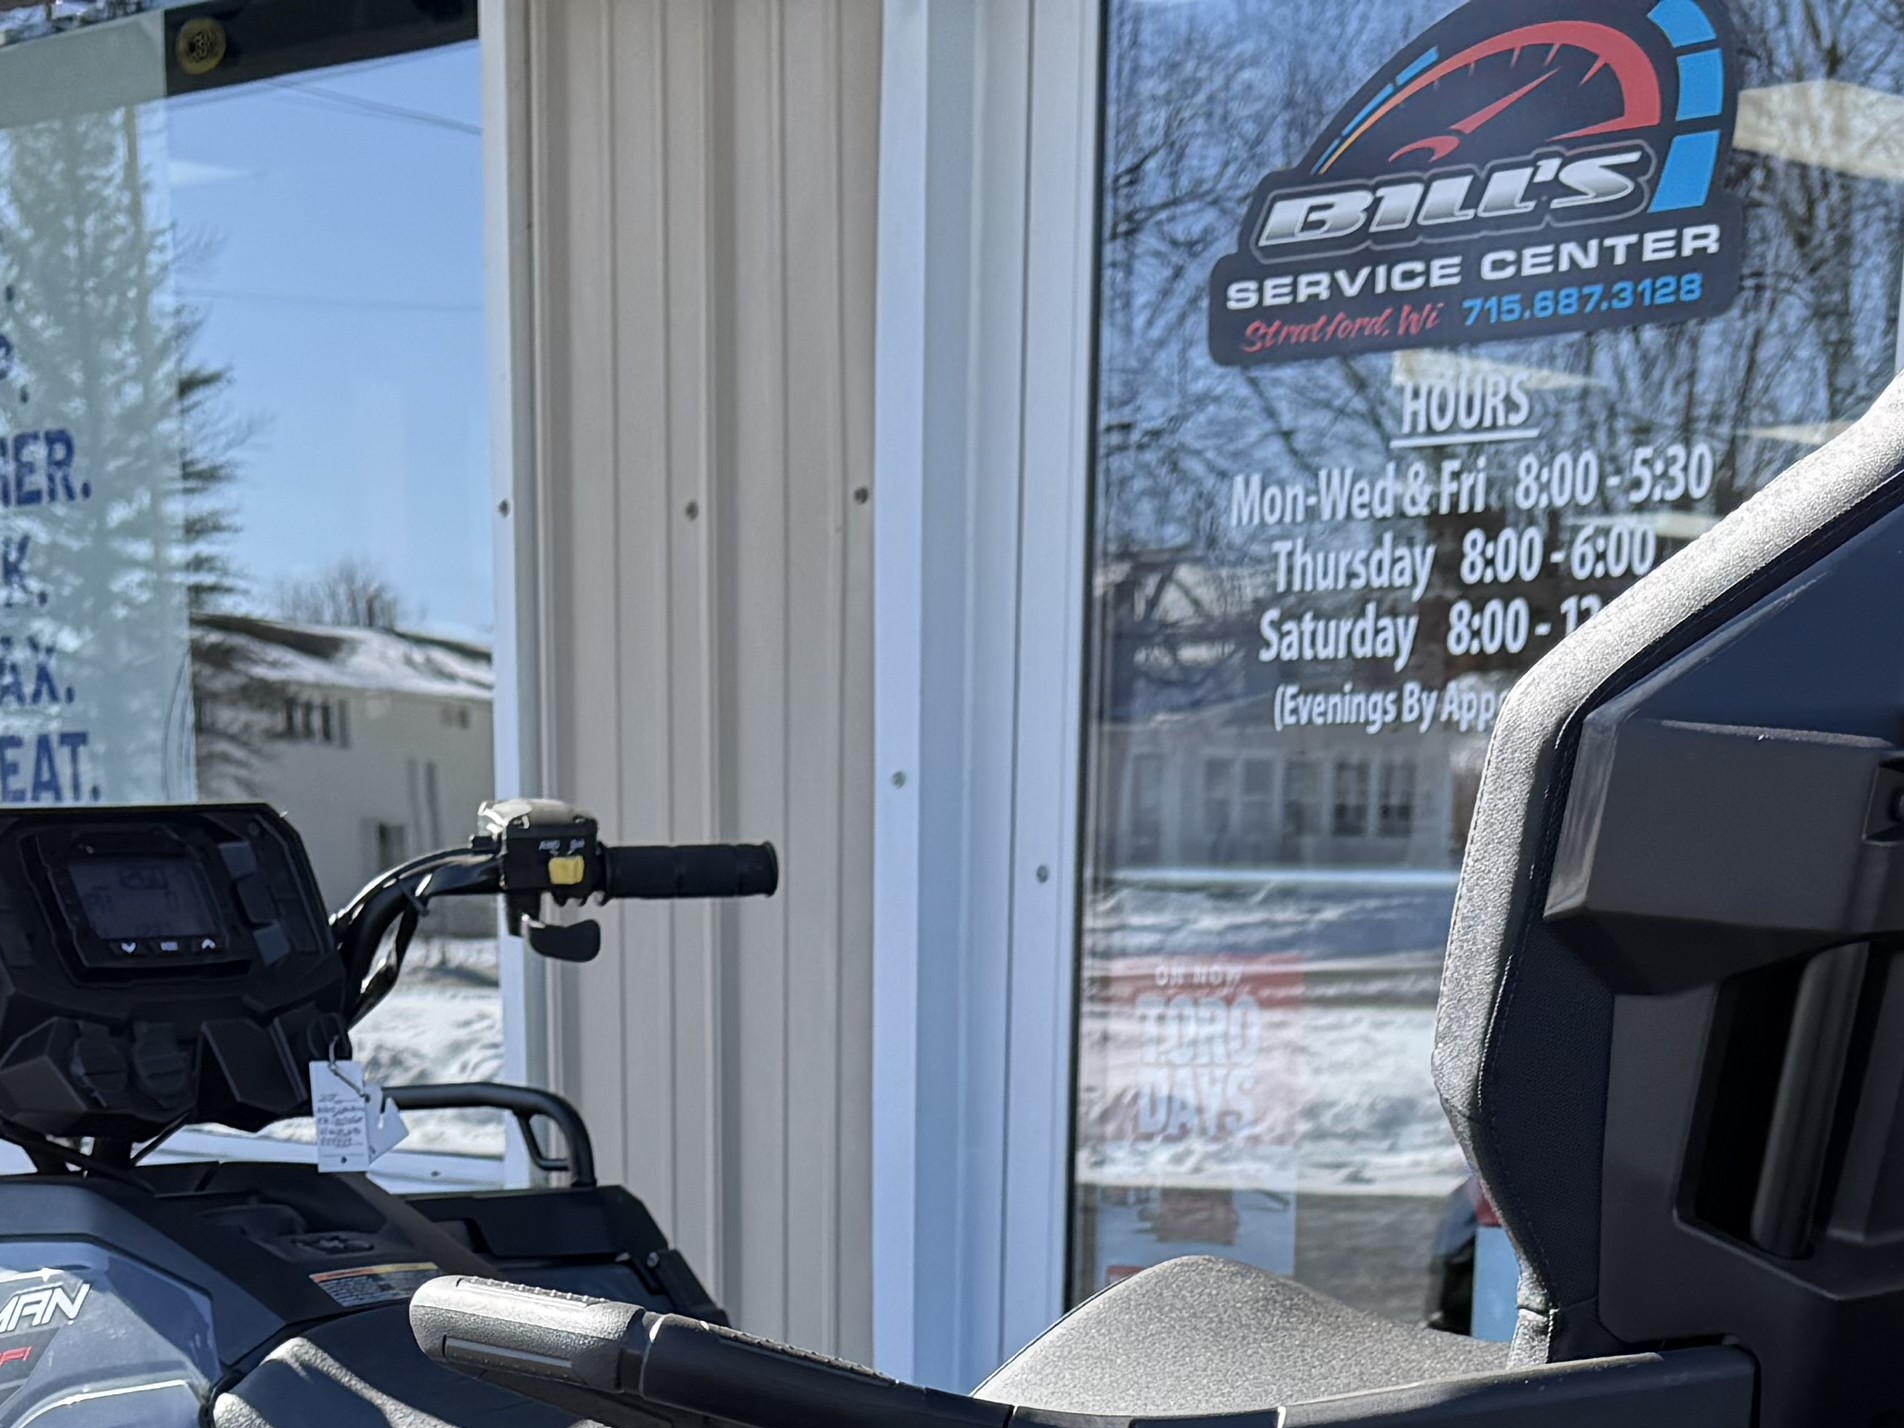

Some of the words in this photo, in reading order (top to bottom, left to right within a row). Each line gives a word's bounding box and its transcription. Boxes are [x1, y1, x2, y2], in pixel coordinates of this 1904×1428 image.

[1258, 150, 1645, 248] BILL'S
[1226, 256, 1462, 311] SERVICE
[1481, 224, 1722, 281] CENTER
[1462, 273, 1704, 328] 715.687.3128
[1400, 379, 1532, 436] HOURS
[1230, 465, 1394, 527] Mon-Wed
[1405, 462, 1432, 516] &
[1439, 456, 1487, 515] Fri
[1515, 450, 1600, 510] 8:00
[1627, 443, 1714, 505] 5:30
[1271, 535, 1437, 602] Thursday
[1460, 526, 1544, 585] 8:00
[1570, 521, 1657, 580] 6:00
[1258, 604, 1419, 672] Saturday
[1446, 597, 1530, 656] 8:00
[1274, 683, 1396, 734] (Evenings
[1401, 680, 1439, 734] By
[1440, 679, 1509, 733] App
